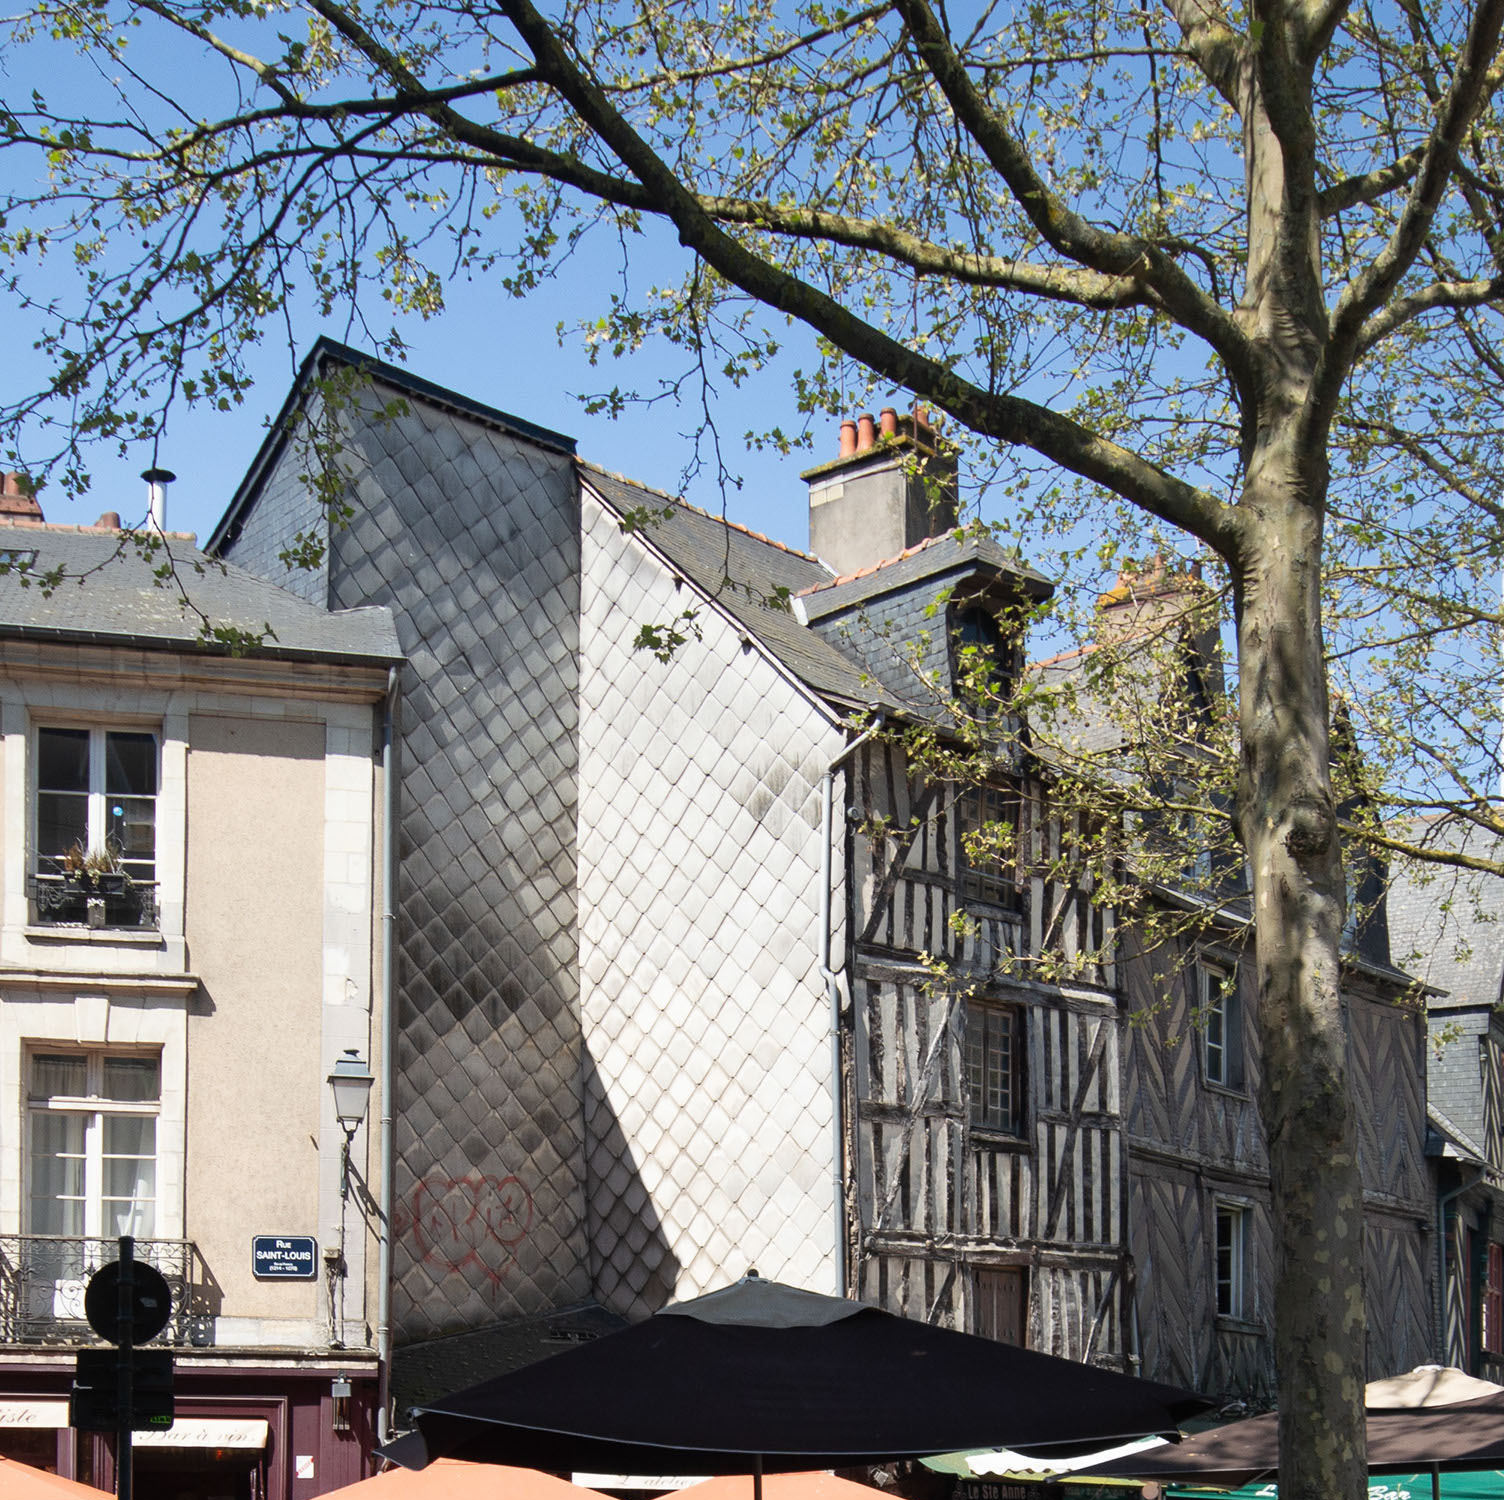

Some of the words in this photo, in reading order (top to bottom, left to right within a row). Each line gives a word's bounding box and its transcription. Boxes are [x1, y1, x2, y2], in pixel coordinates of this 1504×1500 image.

[256, 1251, 312, 1260] SAINT-LOUIS
[967, 1484, 980, 1500] Le
[982, 1485, 999, 1500] Ste
[1001, 1485, 1027, 1500] Anne
